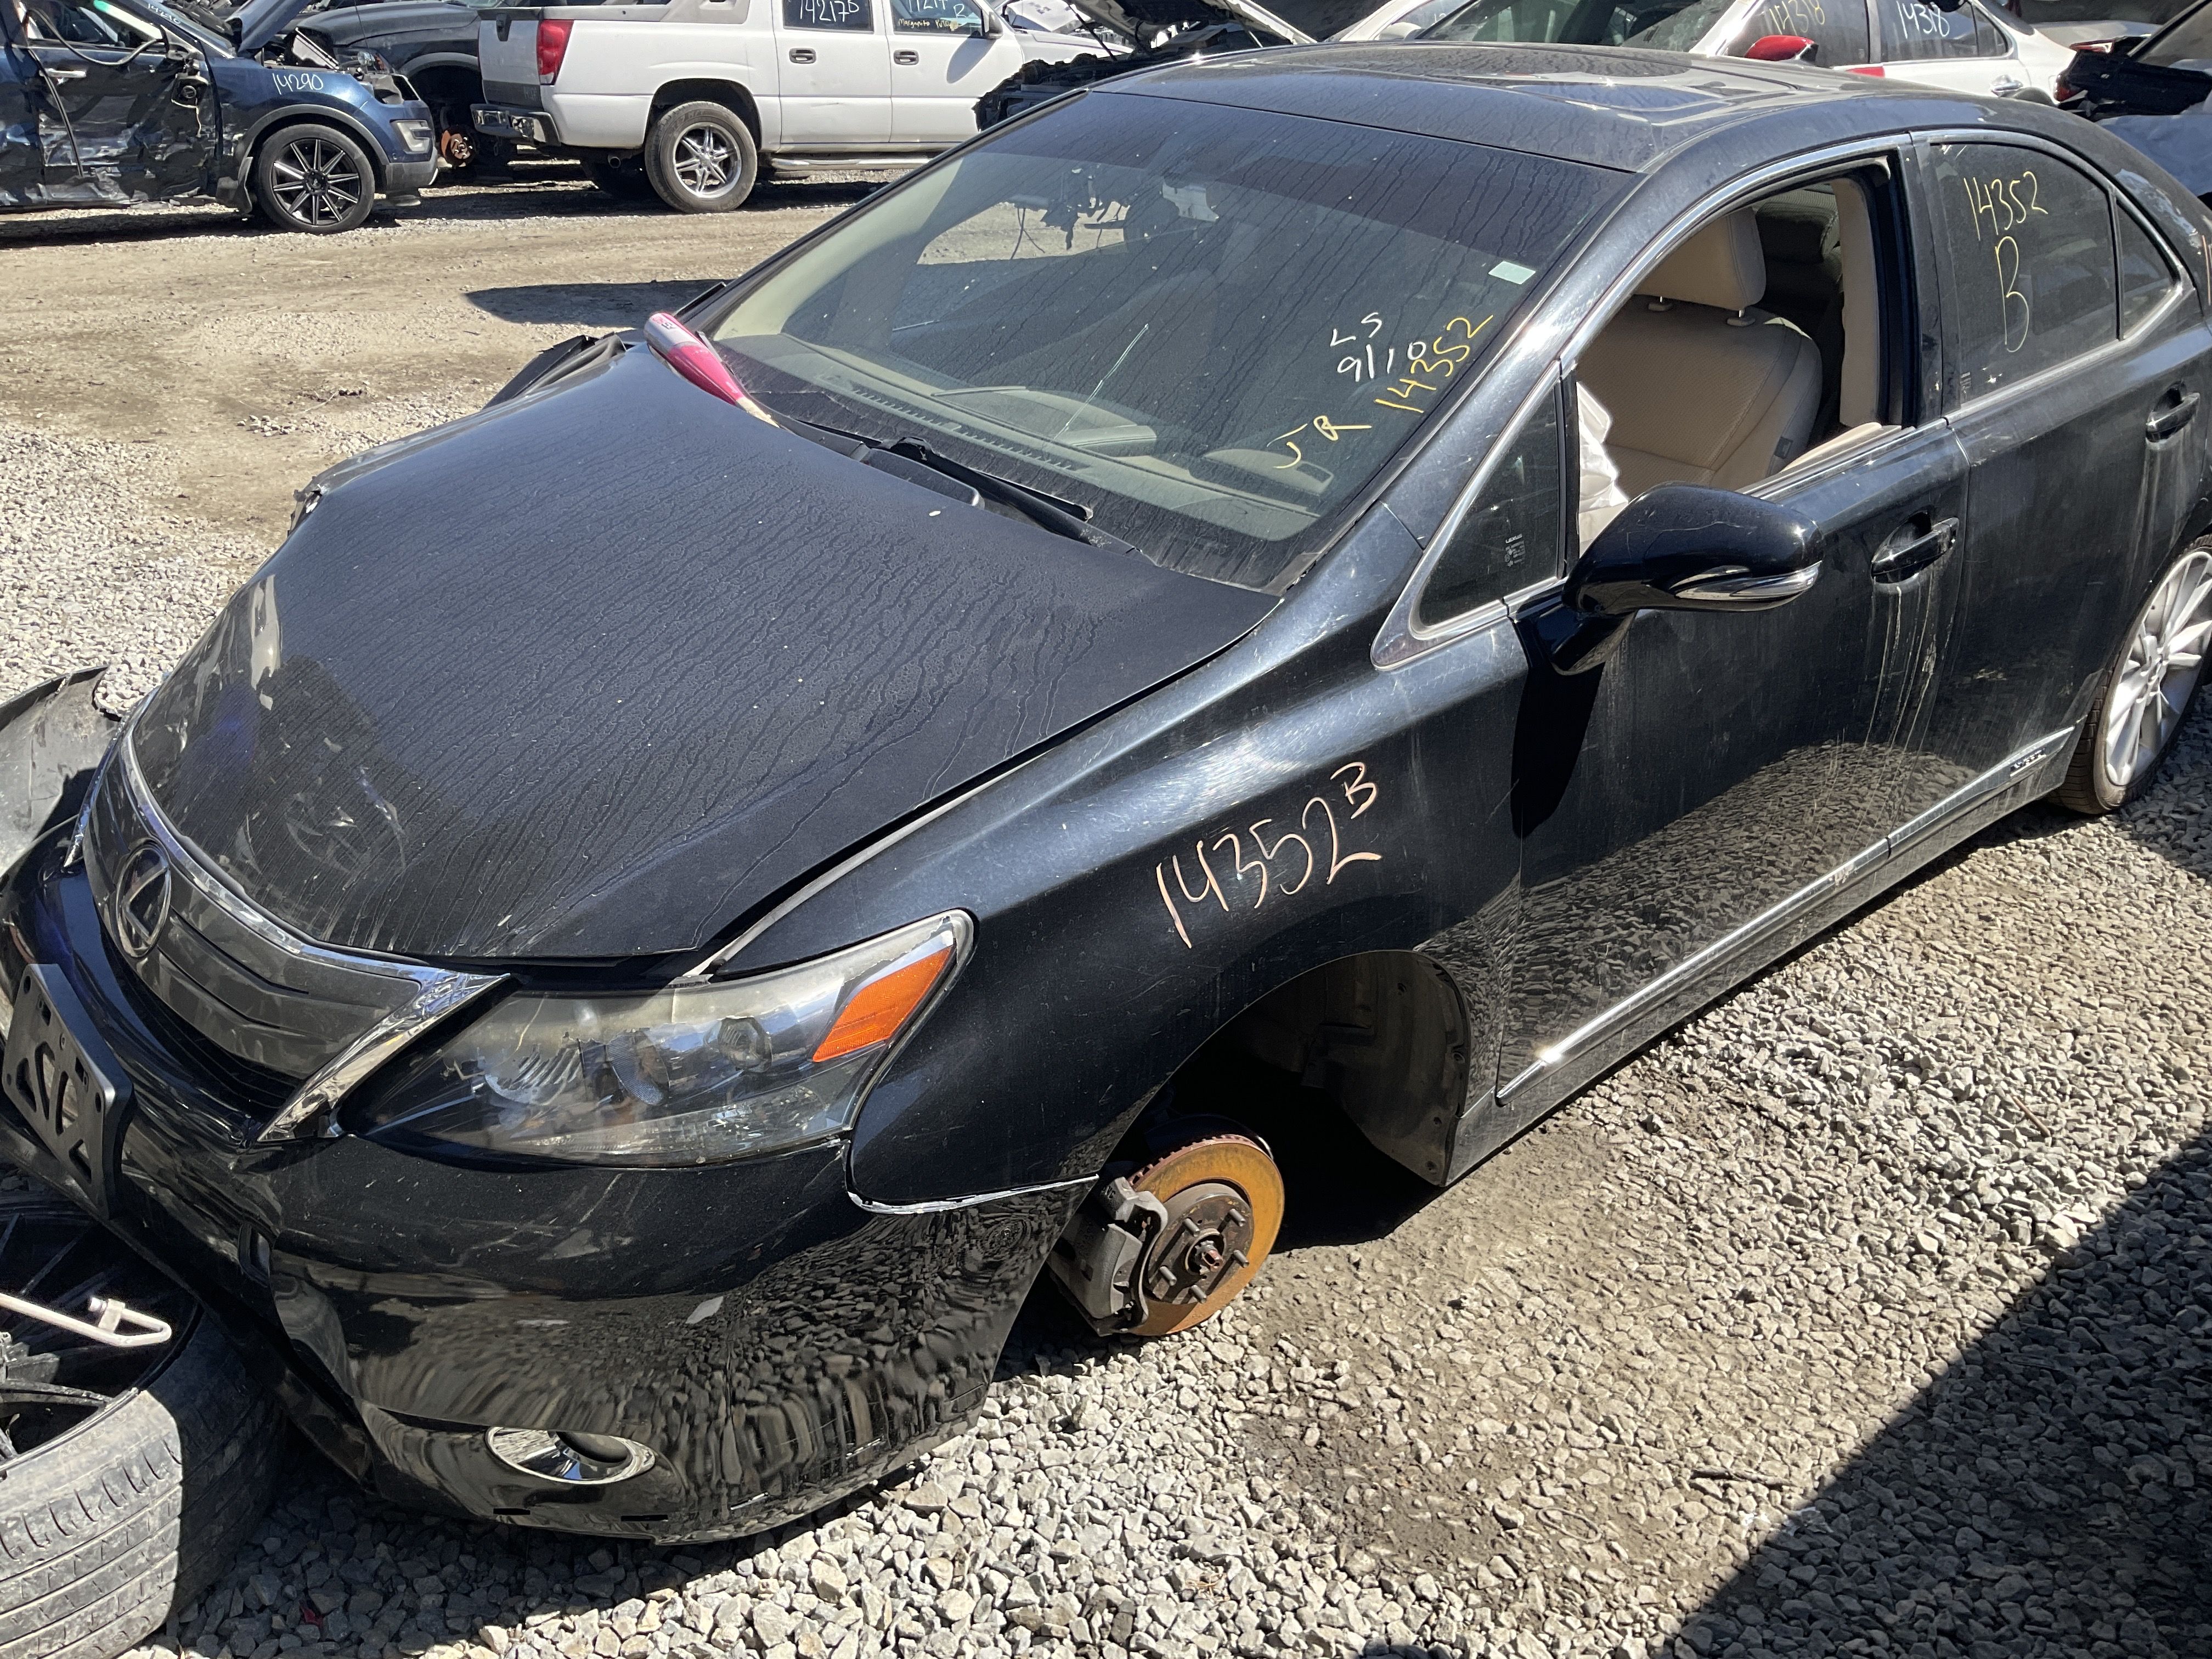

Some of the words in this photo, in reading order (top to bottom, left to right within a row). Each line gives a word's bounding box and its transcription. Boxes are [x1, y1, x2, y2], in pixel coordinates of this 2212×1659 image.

[272, 72, 324, 94] 14290
[1963, 170, 2049, 241] 14352
[1994, 236, 2029, 353] B
[1373, 314, 1493, 414] 14352
[1156, 797, 1383, 949] 14352
[1330, 761, 1378, 820] B
